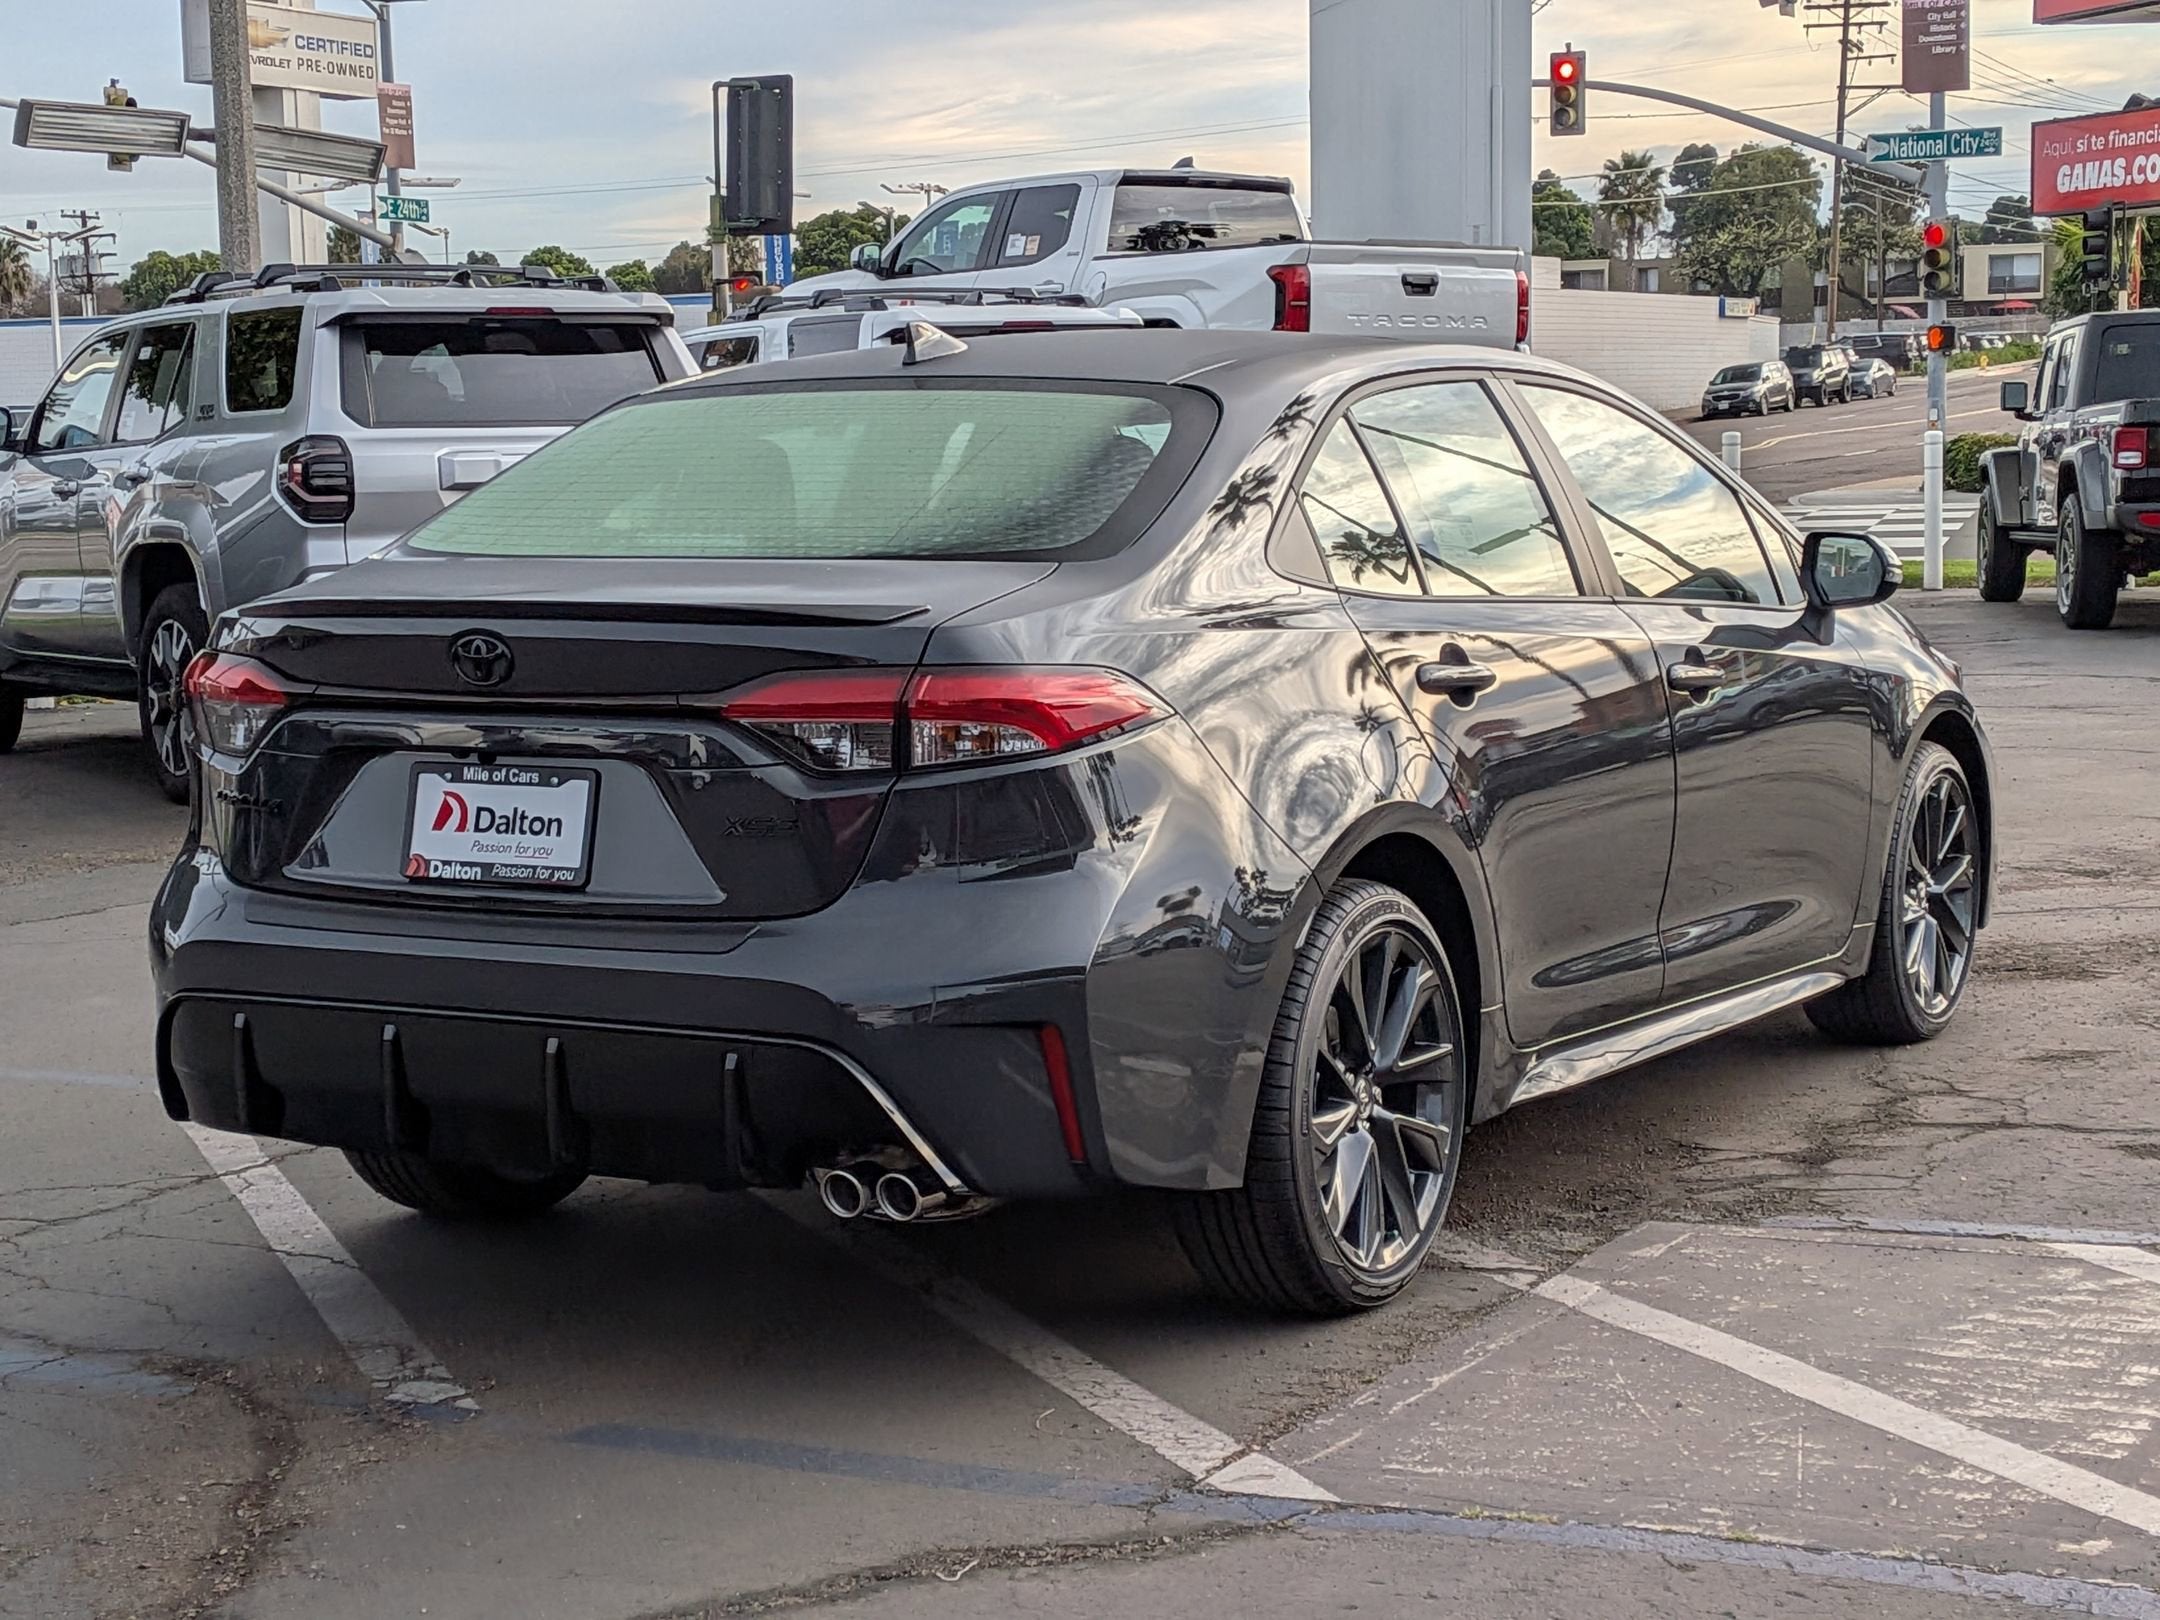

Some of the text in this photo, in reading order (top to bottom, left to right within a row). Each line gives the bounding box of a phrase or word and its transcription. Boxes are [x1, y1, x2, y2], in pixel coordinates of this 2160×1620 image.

[1927, 12, 1941, 21] City
[295, 34, 374, 58] CERTIFIED
[1918, 34, 1957, 43] Downtown
[1931, 46, 1957, 54] Library
[250, 55, 292, 69] VROLET
[297, 57, 374, 79] PRE-OWNED
[1889, 132, 1981, 159] National City
[2042, 137, 2074, 158] Aquí,
[2076, 134, 2089, 153] sí
[2091, 135, 2105, 151] te
[386, 198, 420, 220] E 24th
[1346, 313, 1488, 329] TACOMA
[463, 766, 540, 784] Mile of Cars
[473, 805, 563, 837] Dalton
[471, 840, 554, 858] Passion for you
[429, 860, 576, 882] Dalton Passion for you
